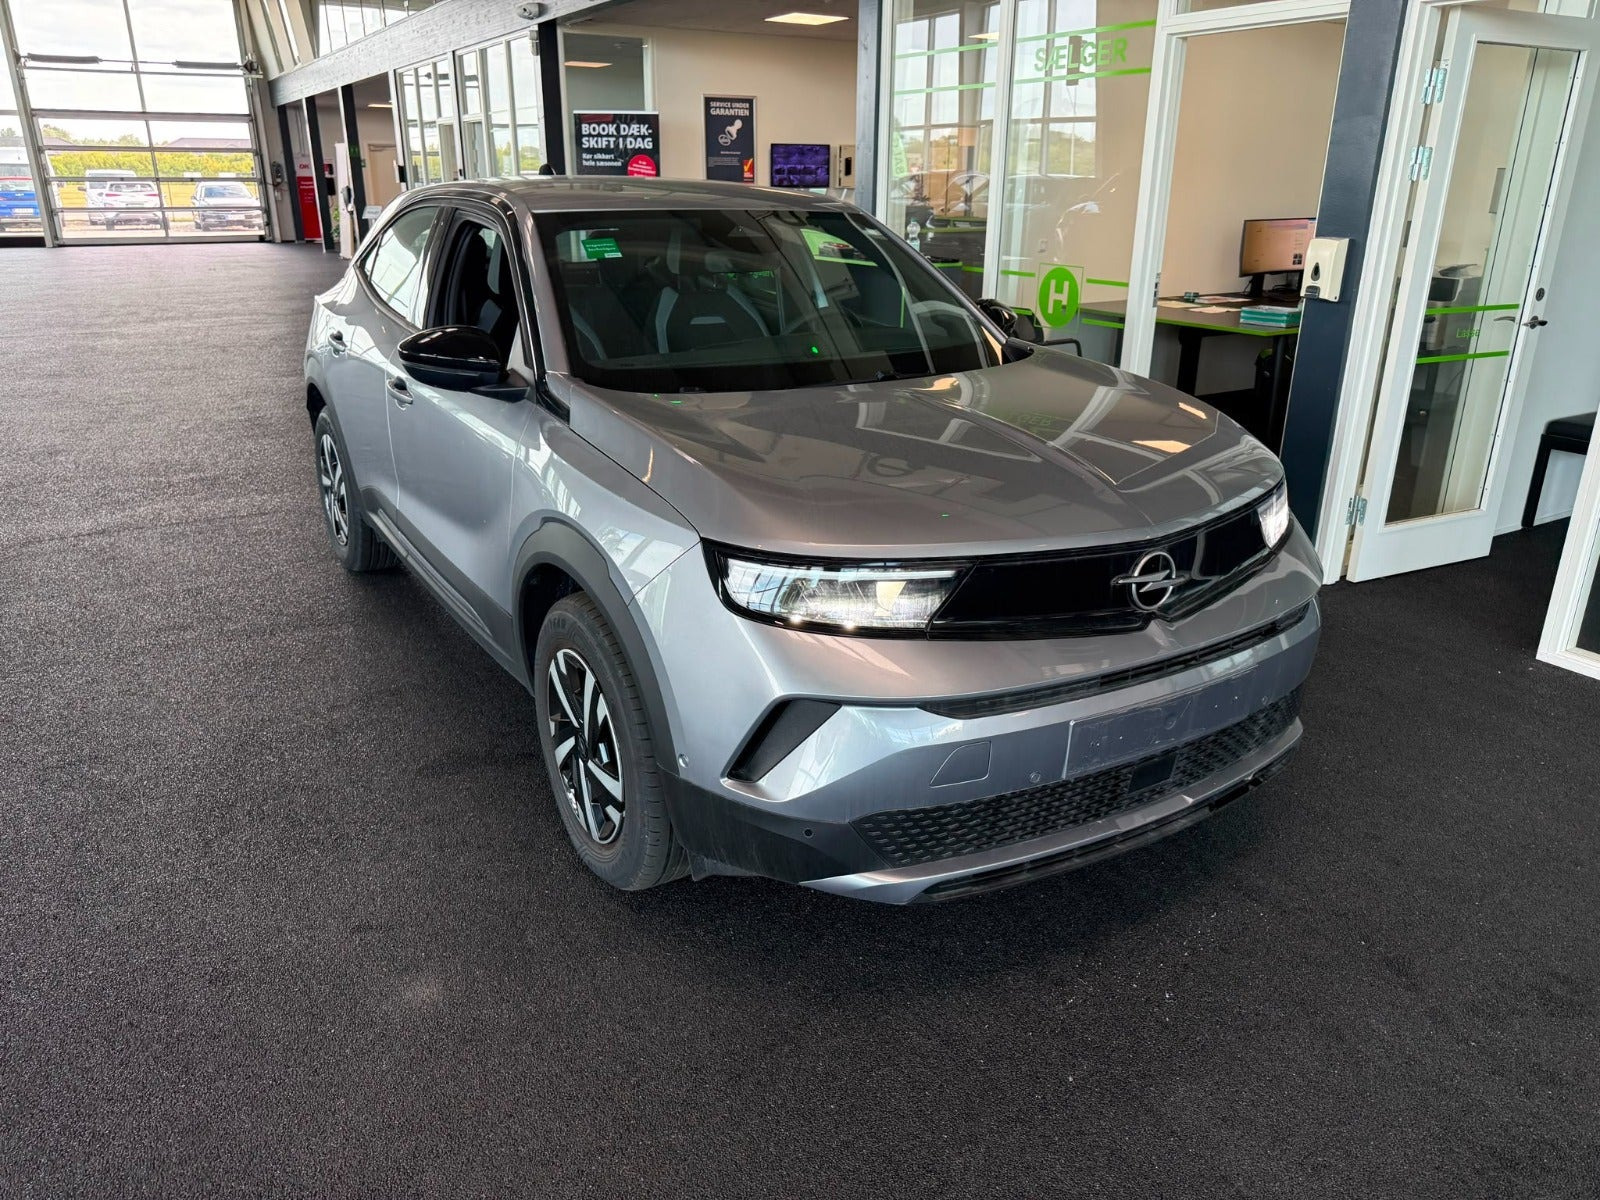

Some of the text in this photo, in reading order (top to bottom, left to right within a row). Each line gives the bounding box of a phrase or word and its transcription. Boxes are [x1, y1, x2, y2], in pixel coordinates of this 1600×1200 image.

[1034, 37, 1128, 72] SÆLGER
[710, 108, 750, 116] GARANTIEN
[581, 123, 653, 136] BOOK DÆK-
[581, 137, 653, 149] SKIFT I DAG
